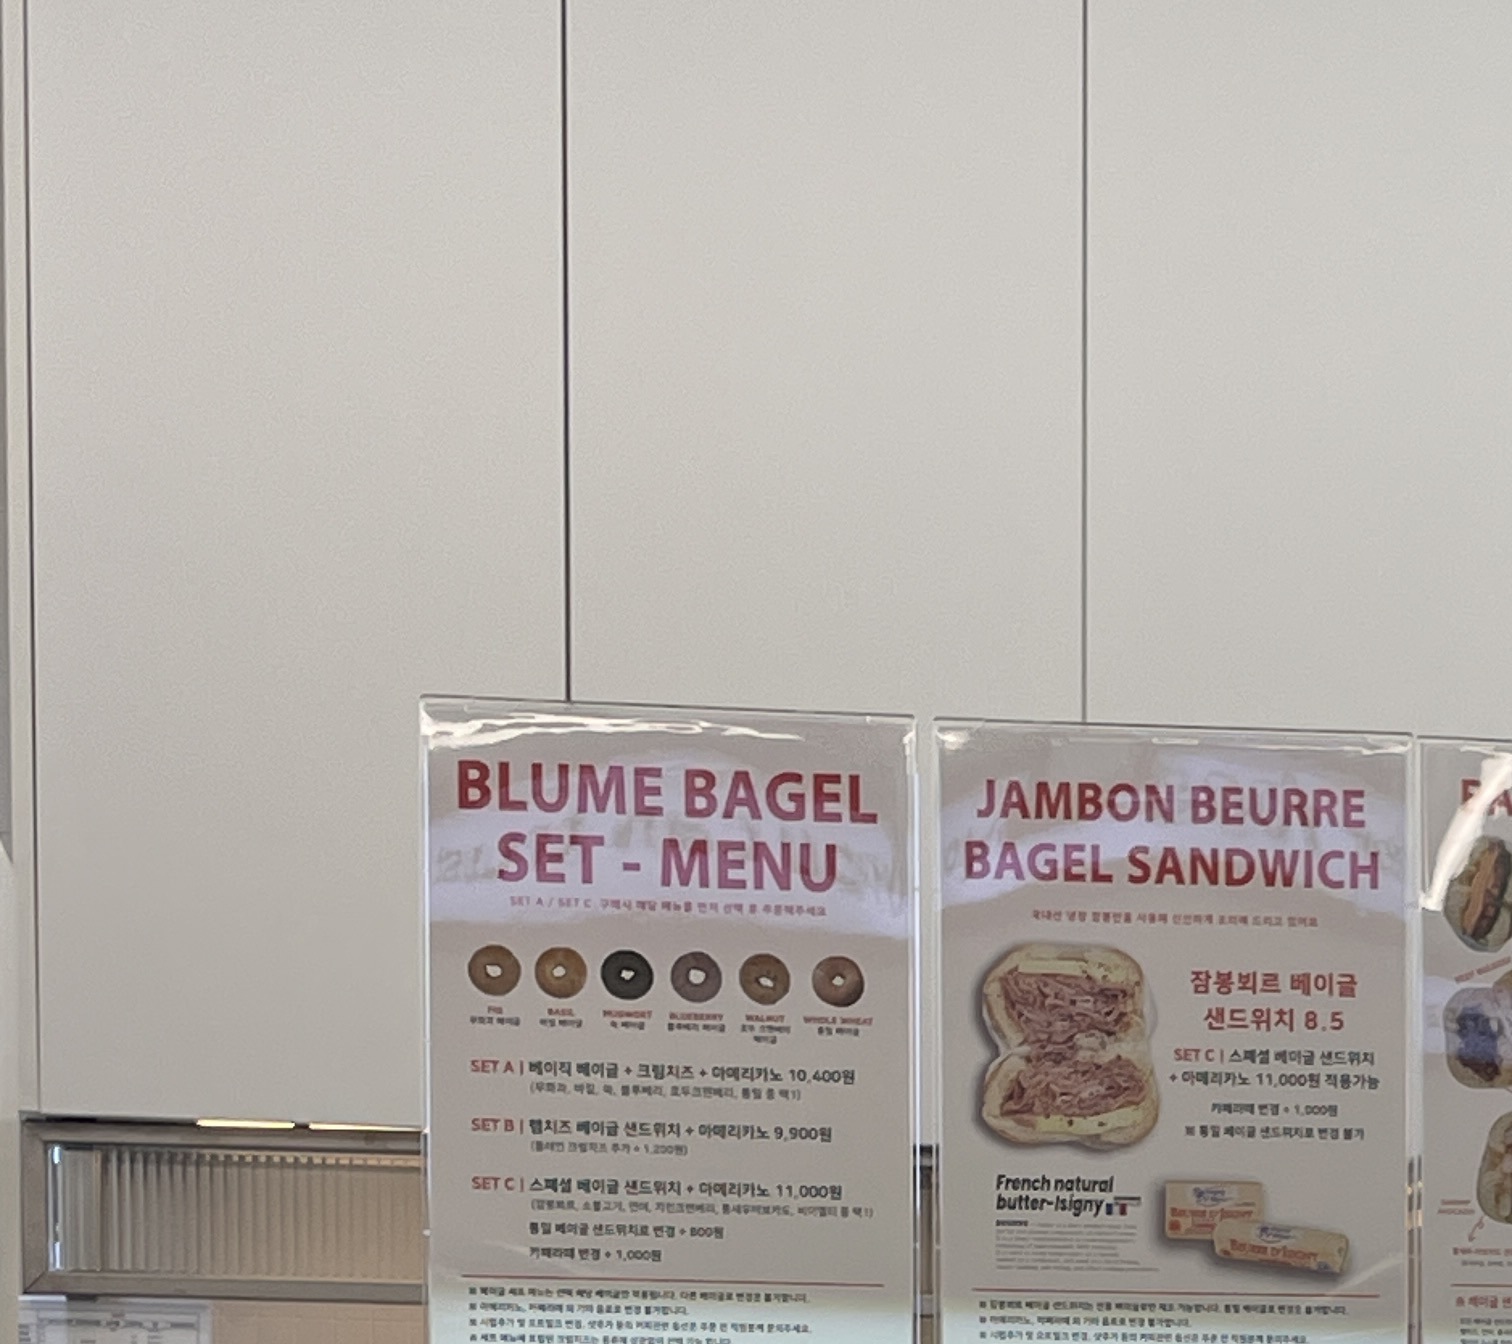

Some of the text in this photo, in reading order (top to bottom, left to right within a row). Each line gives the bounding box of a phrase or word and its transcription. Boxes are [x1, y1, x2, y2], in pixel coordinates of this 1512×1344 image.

[458, 760, 878, 824] BLUME BAGEL
[977, 779, 1365, 828] JAMBON BEURRE
[497, 832, 604, 884] SET
[661, 837, 837, 892] MENU
[965, 840, 1380, 890] BAGEL SANDWICH
[1190, 970, 1358, 998] 잠봉뵈르 베이글
[1204, 1007, 1345, 1032] 샌드위치 8.5
[1174, 1048, 1201, 1062] SET
[1205, 1049, 1215, 1062] C
[470, 1059, 499, 1073] SET
[503, 1061, 514, 1073] A
[576, 1062, 618, 1079] 베이글
[636, 1063, 694, 1080] 크림치즈
[712, 1066, 783, 1082] 아메리카노
[789, 1069, 856, 1085] 10,400원
[1182, 1072, 1251, 1087] 아메리카노
[1256, 1073, 1321, 1088] 11,000원
[471, 1118, 499, 1131] SET
[504, 1119, 514, 1131] B
[576, 1120, 618, 1137] 베이글
[624, 1121, 681, 1138] 샌드위치
[699, 1123, 770, 1139] 아메리카노
[774, 1126, 833, 1143] 9,900원
[471, 1176, 499, 1190] SET
[505, 1177, 514, 1190] C
[576, 1179, 619, 1195] 베이글
[624, 1179, 681, 1196] 샌드위치
[699, 1182, 770, 1198] 아메리카노
[775, 1184, 843, 1200] 11,000원
[996, 1174, 1114, 1192] French natural
